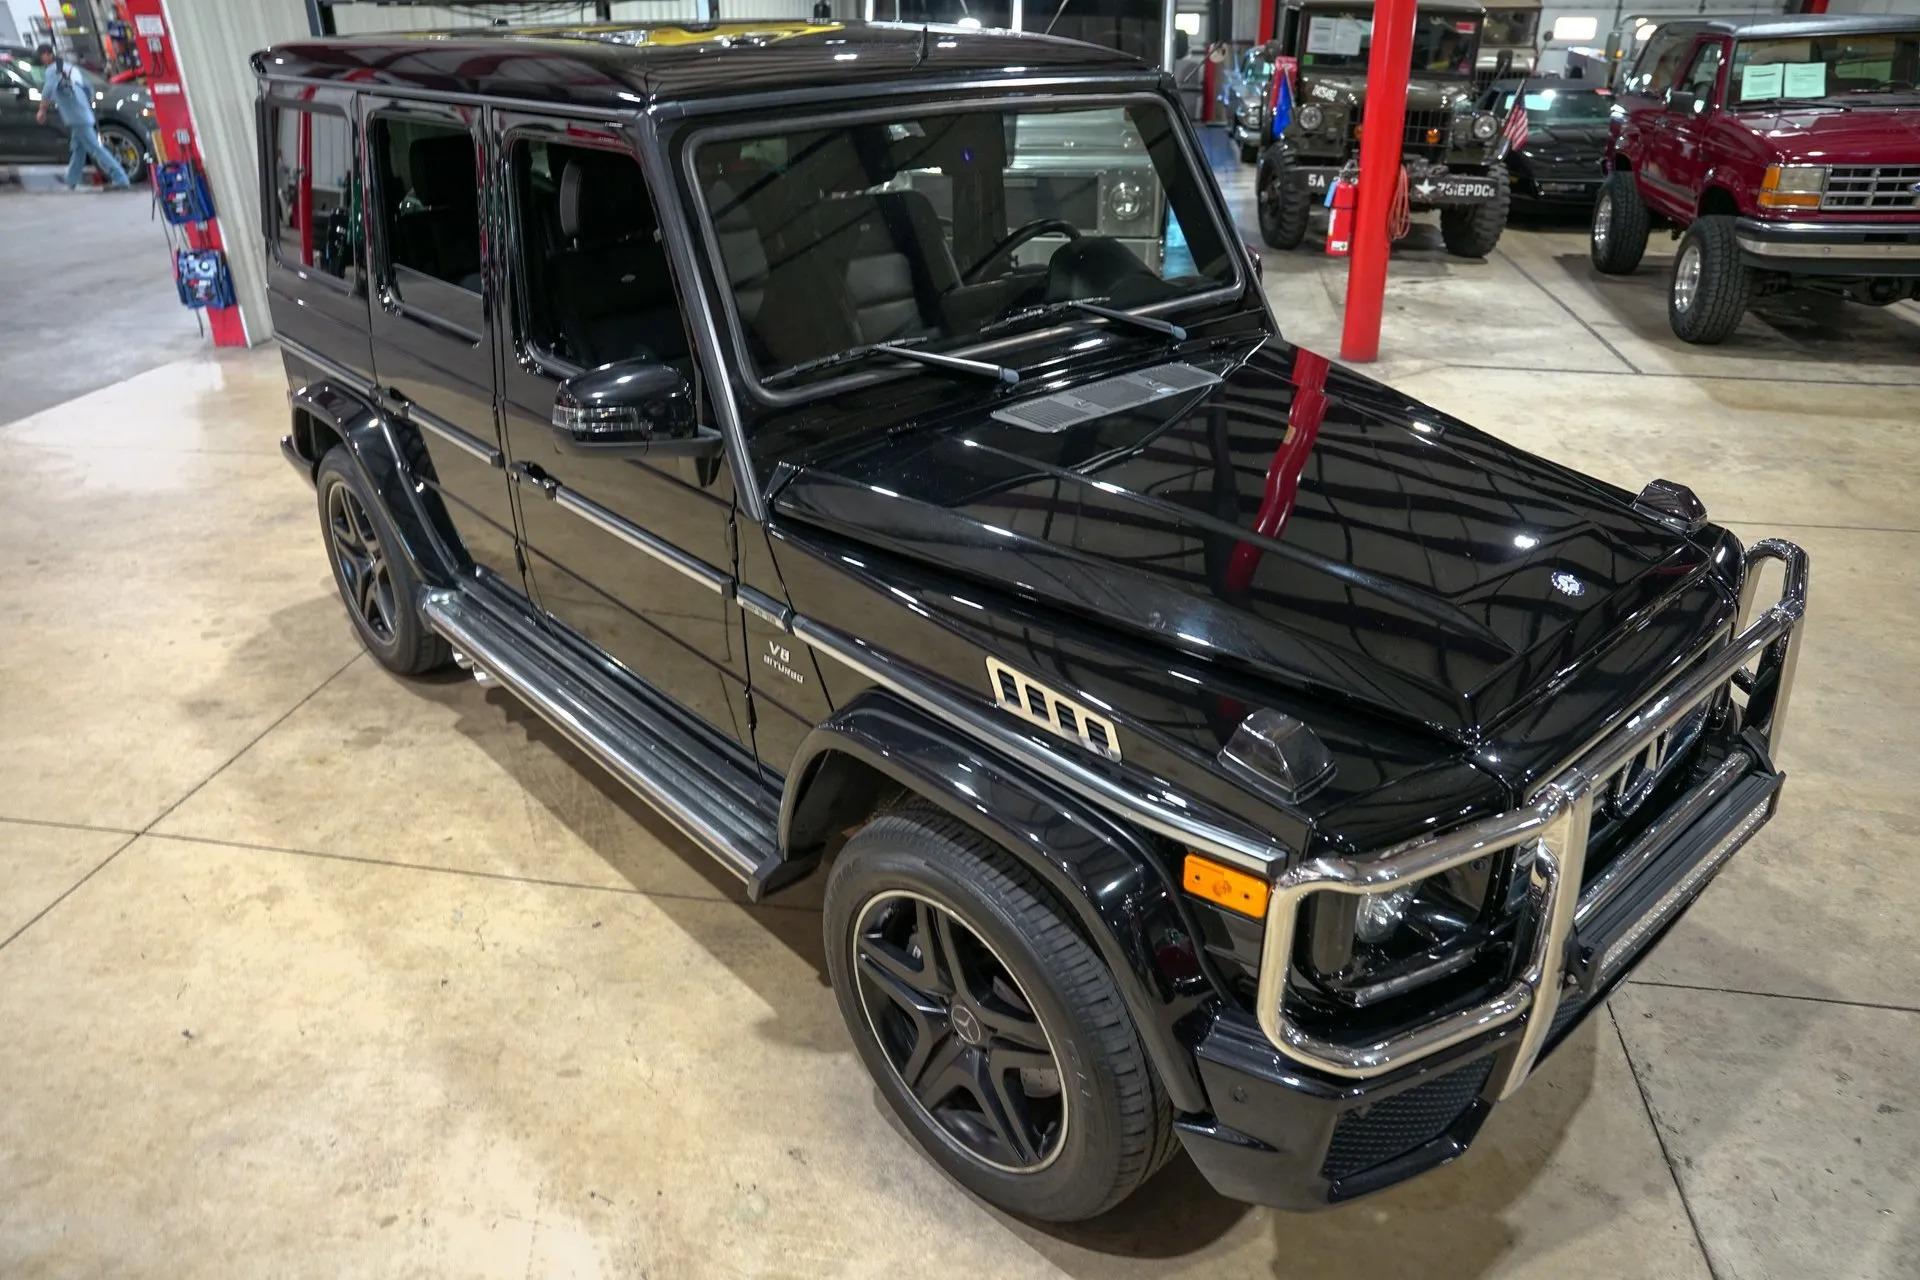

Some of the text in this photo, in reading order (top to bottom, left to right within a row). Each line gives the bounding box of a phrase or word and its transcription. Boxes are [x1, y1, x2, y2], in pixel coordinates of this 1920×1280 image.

[1308, 173, 1325, 188] 5A
[768, 640, 791, 663] V8
[763, 654, 805, 684] BITURBO
